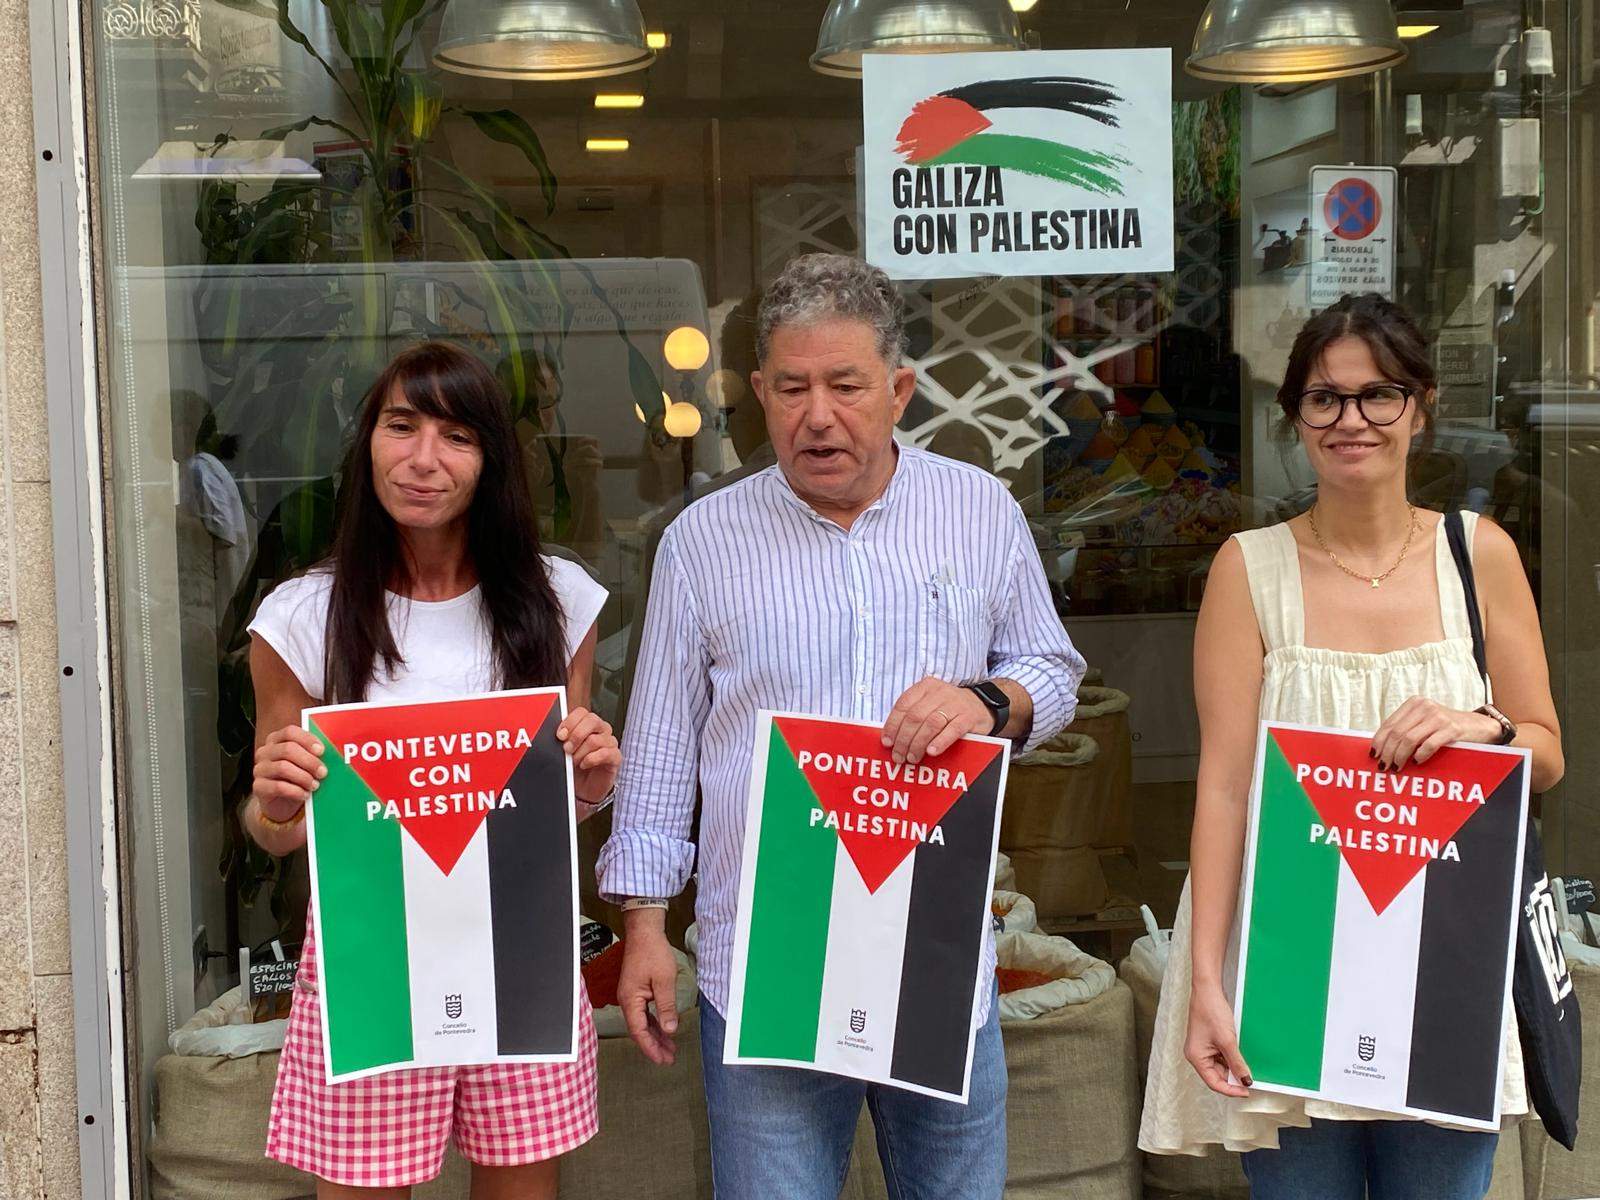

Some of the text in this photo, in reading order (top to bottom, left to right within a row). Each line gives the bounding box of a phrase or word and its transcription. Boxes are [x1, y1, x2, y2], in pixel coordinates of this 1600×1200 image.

[893, 165, 1004, 209] GALIZA
[893, 208, 1142, 255] CON PALESTINA
[343, 728, 532, 764] PONTEVEDRA
[409, 763, 471, 788] CON
[798, 750, 968, 792] PONTEVEDRA
[1296, 763, 1486, 804] PONTEVEDRA
[366, 788, 518, 821] PALESTINA
[852, 786, 909, 811] CON
[1355, 800, 1418, 826] CON
[809, 808, 945, 846] PALESTINA
[1309, 823, 1461, 862] PALESTINA
[253, 972, 291, 983] CALLOS
